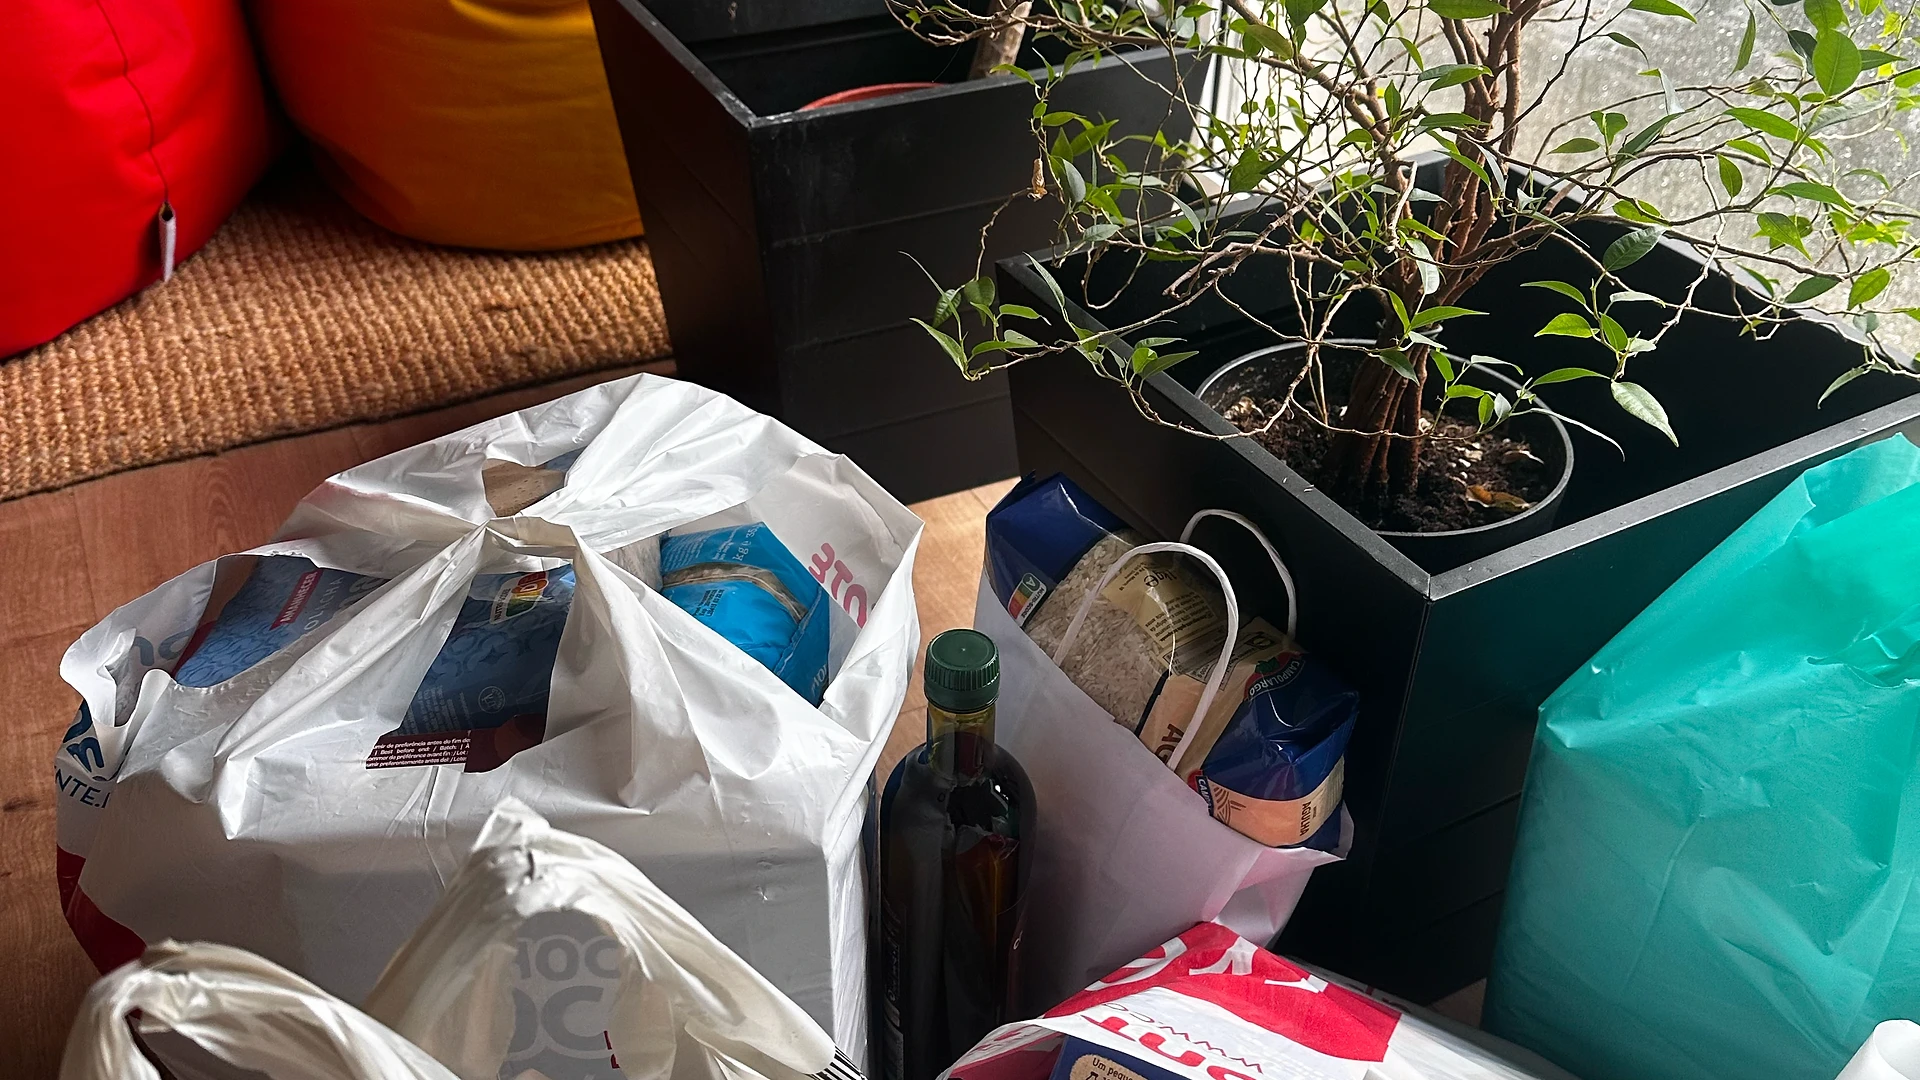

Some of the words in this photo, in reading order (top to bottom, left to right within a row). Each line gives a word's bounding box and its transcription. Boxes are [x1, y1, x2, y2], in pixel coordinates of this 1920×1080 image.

[520, 583, 538, 592] D
[1026, 576, 1036, 587] A
[280, 571, 318, 622] AMANHECER
[1249, 660, 1300, 696] CAMPOLARGO
[1300, 801, 1311, 836] AGULHA
[1092, 1057, 1106, 1071] Um
